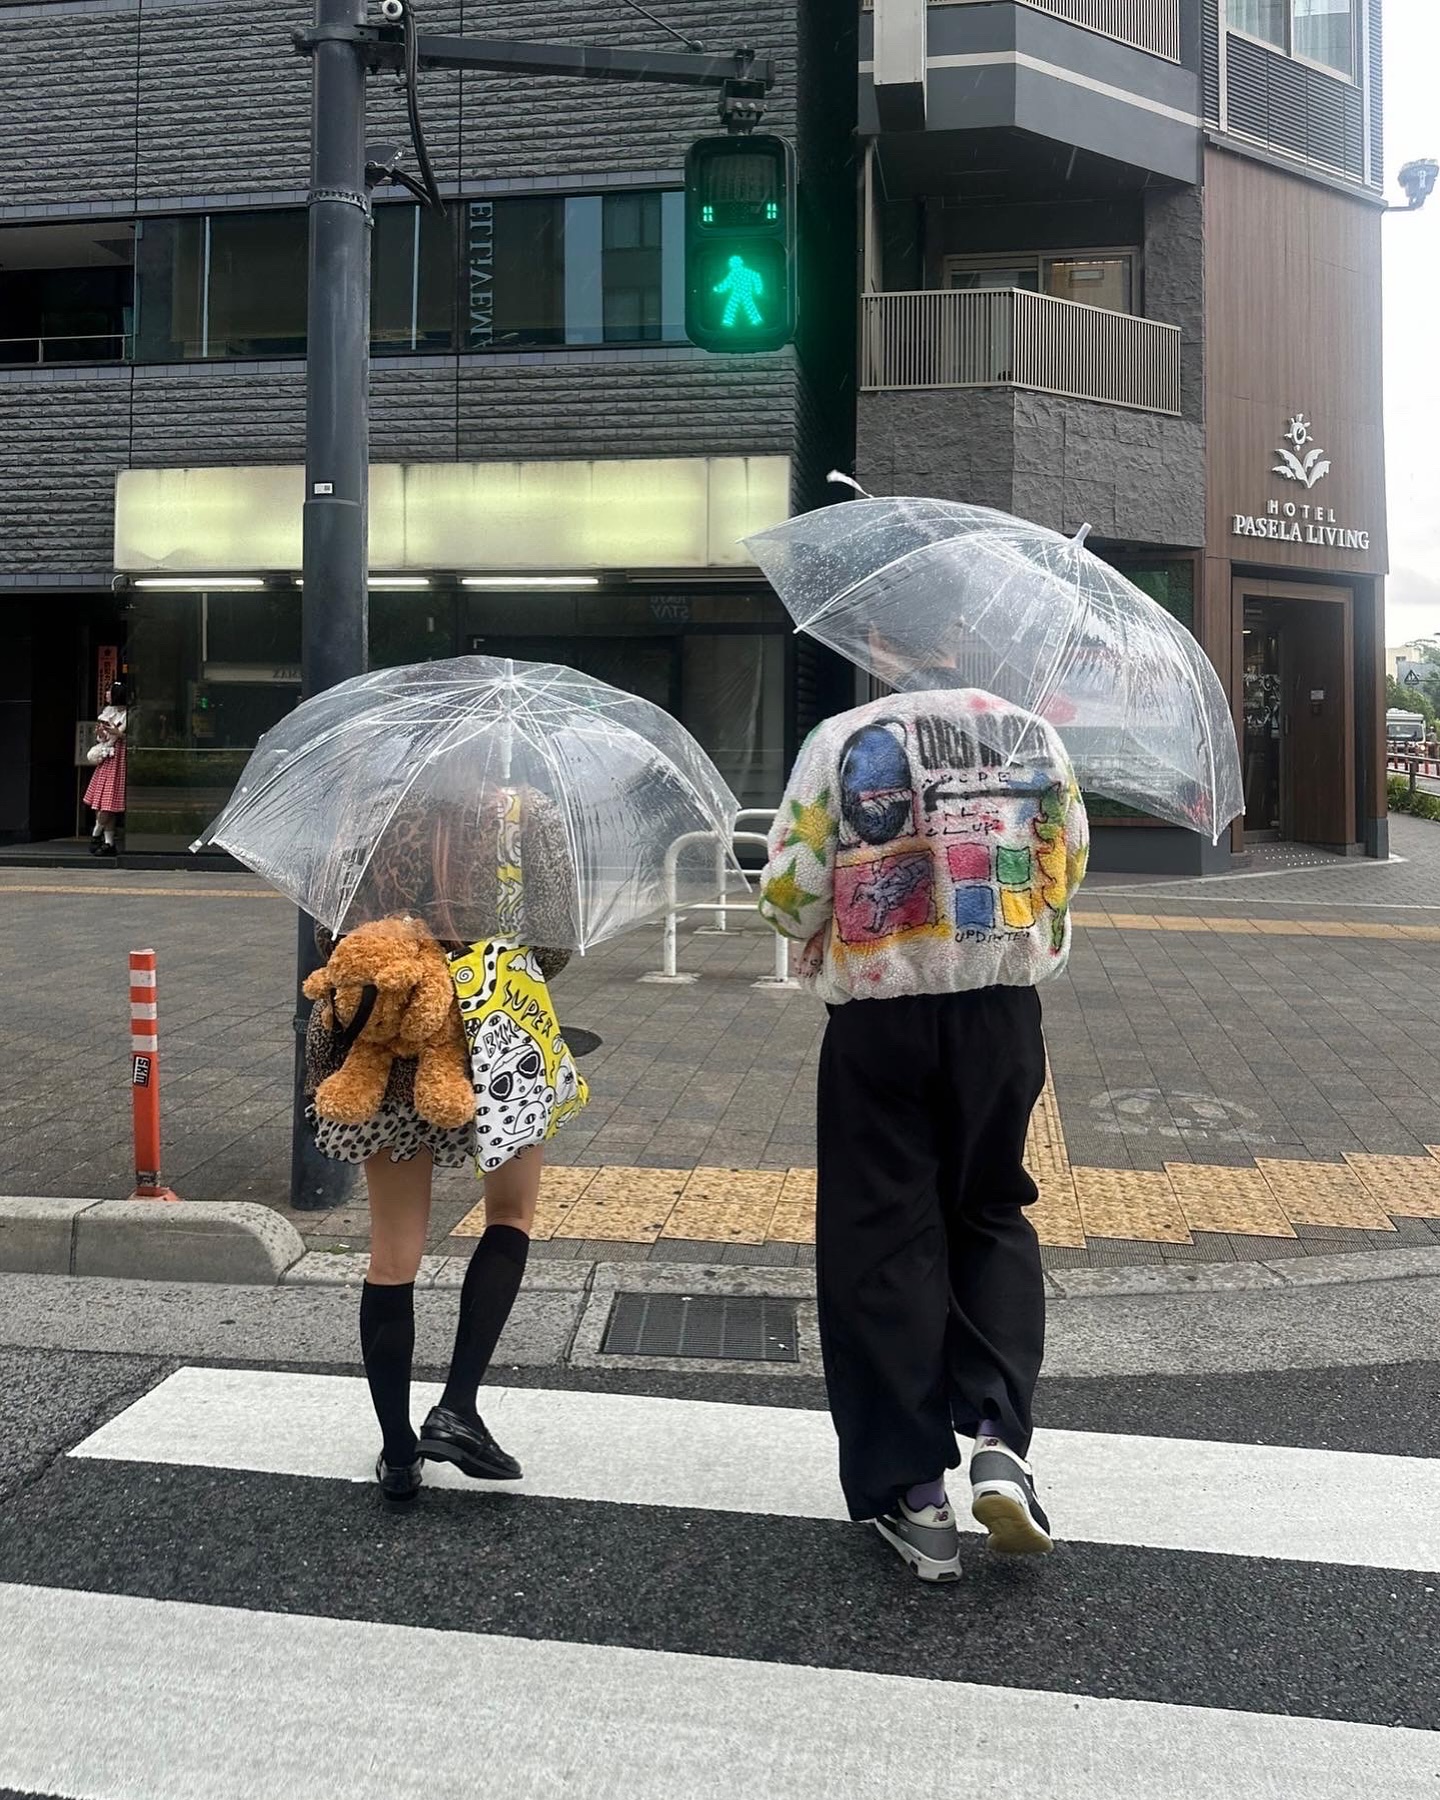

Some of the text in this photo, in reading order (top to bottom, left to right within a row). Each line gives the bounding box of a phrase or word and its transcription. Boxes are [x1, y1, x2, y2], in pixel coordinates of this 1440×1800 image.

[1267, 499, 1336, 523] HOTEL
[1231, 514, 1370, 550] PASELA LIVING
[502, 979, 552, 1038] SUPER
